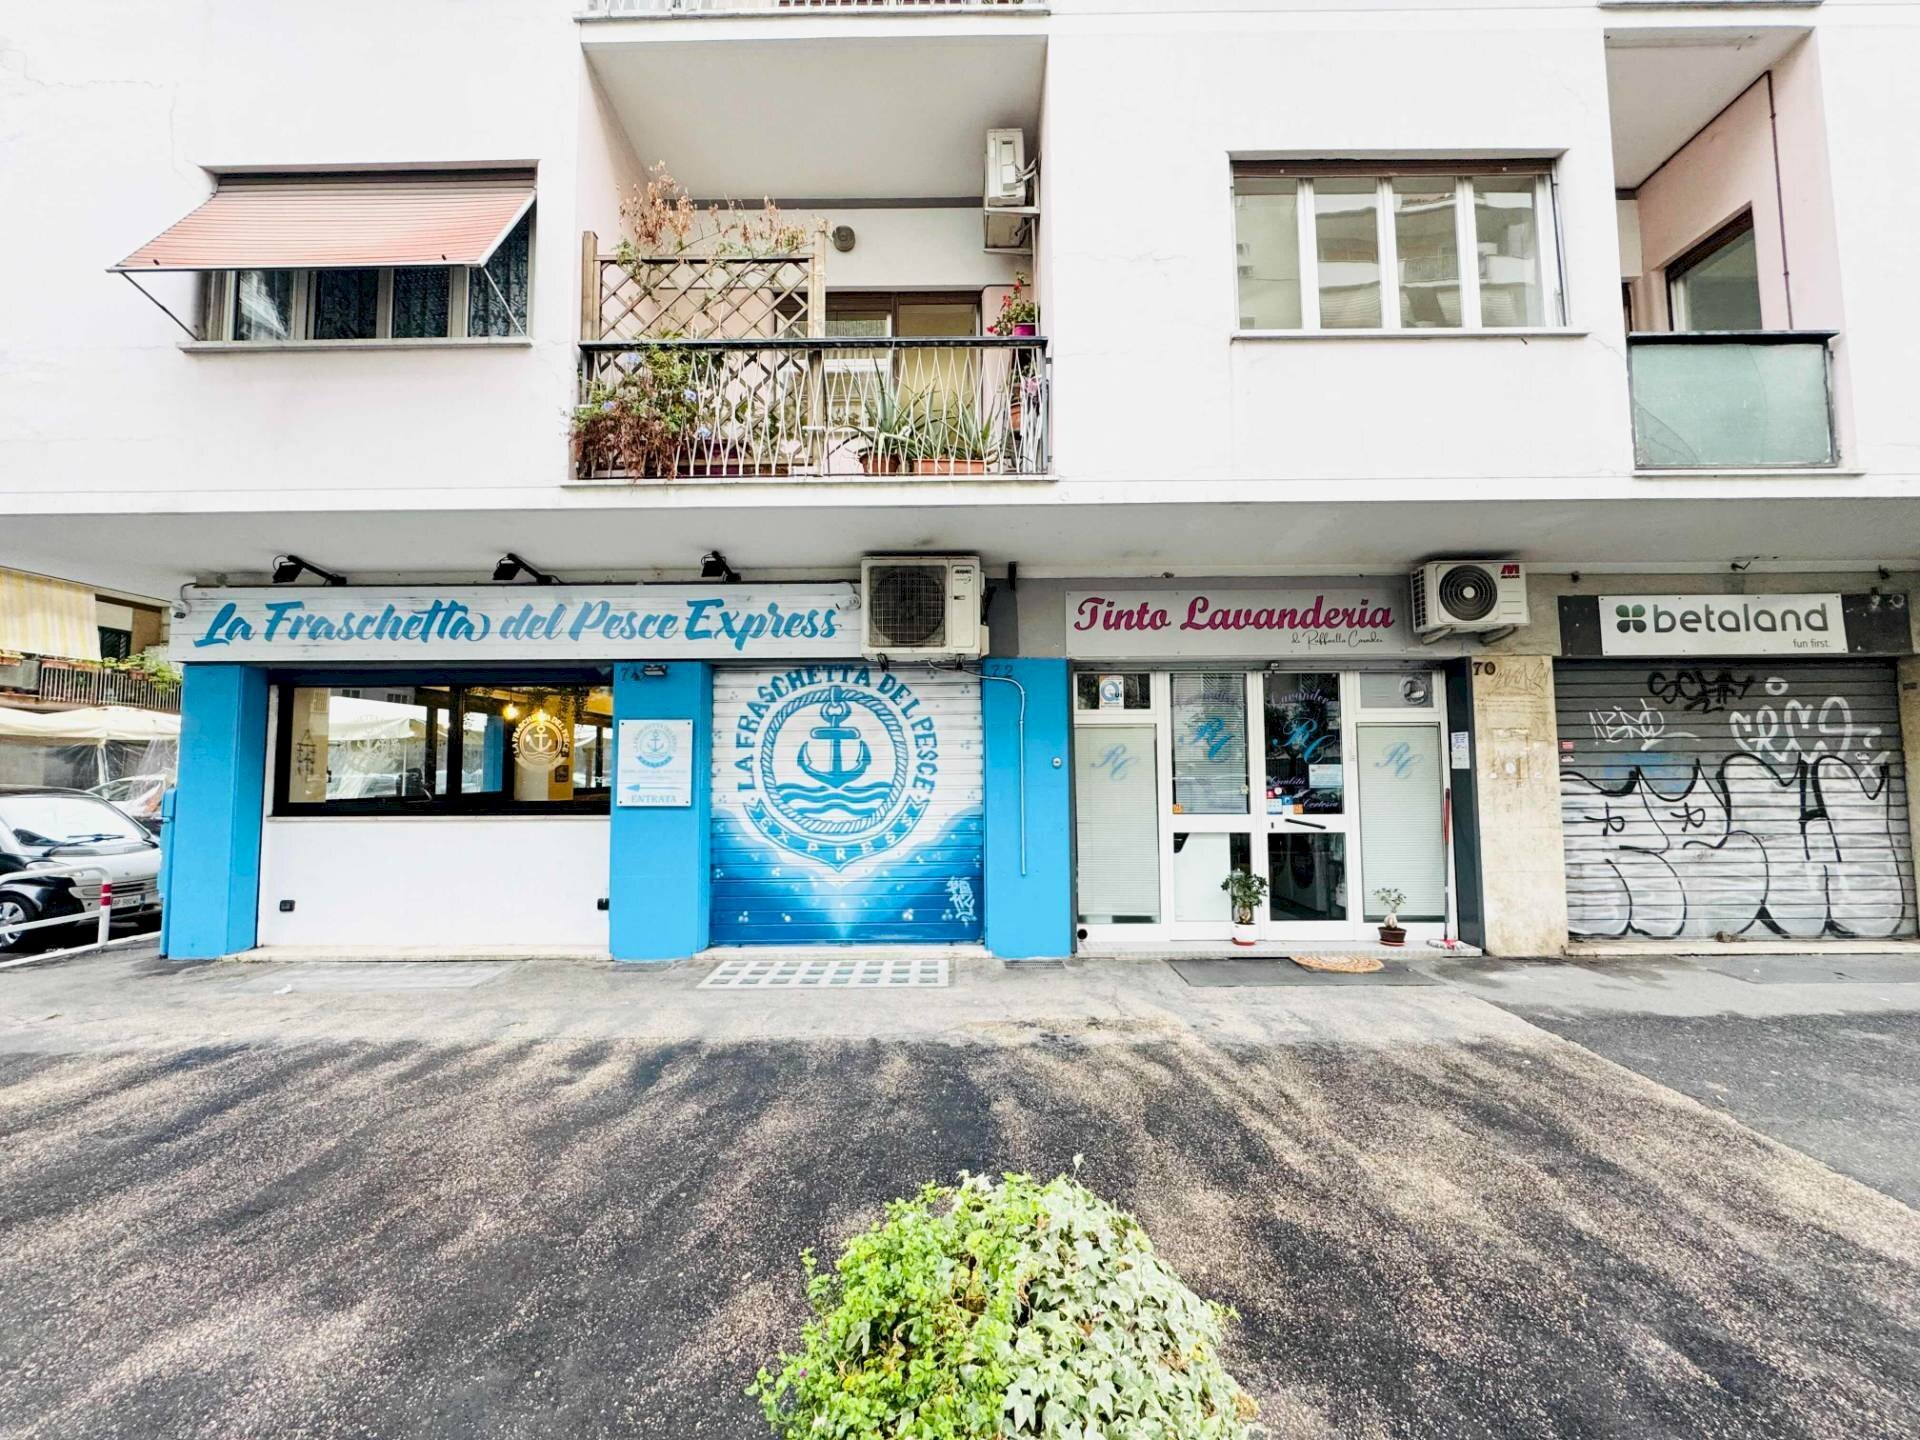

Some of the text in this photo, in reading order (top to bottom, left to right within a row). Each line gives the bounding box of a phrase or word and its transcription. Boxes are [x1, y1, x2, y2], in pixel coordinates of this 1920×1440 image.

[193, 598, 842, 651] La Fraschetta del Pesce Express
[1074, 595, 1395, 631] Tinto Lavanderia
[1652, 602, 1829, 633] betaland
[1792, 639, 1809, 649] fun
[1472, 661, 1496, 676] 70
[735, 664, 871, 749] FRASCHETTA
[876, 673, 921, 720] DEL
[734, 753, 757, 793] LA
[910, 716, 939, 795] PESCE
[760, 812, 914, 861] EXPRESS
